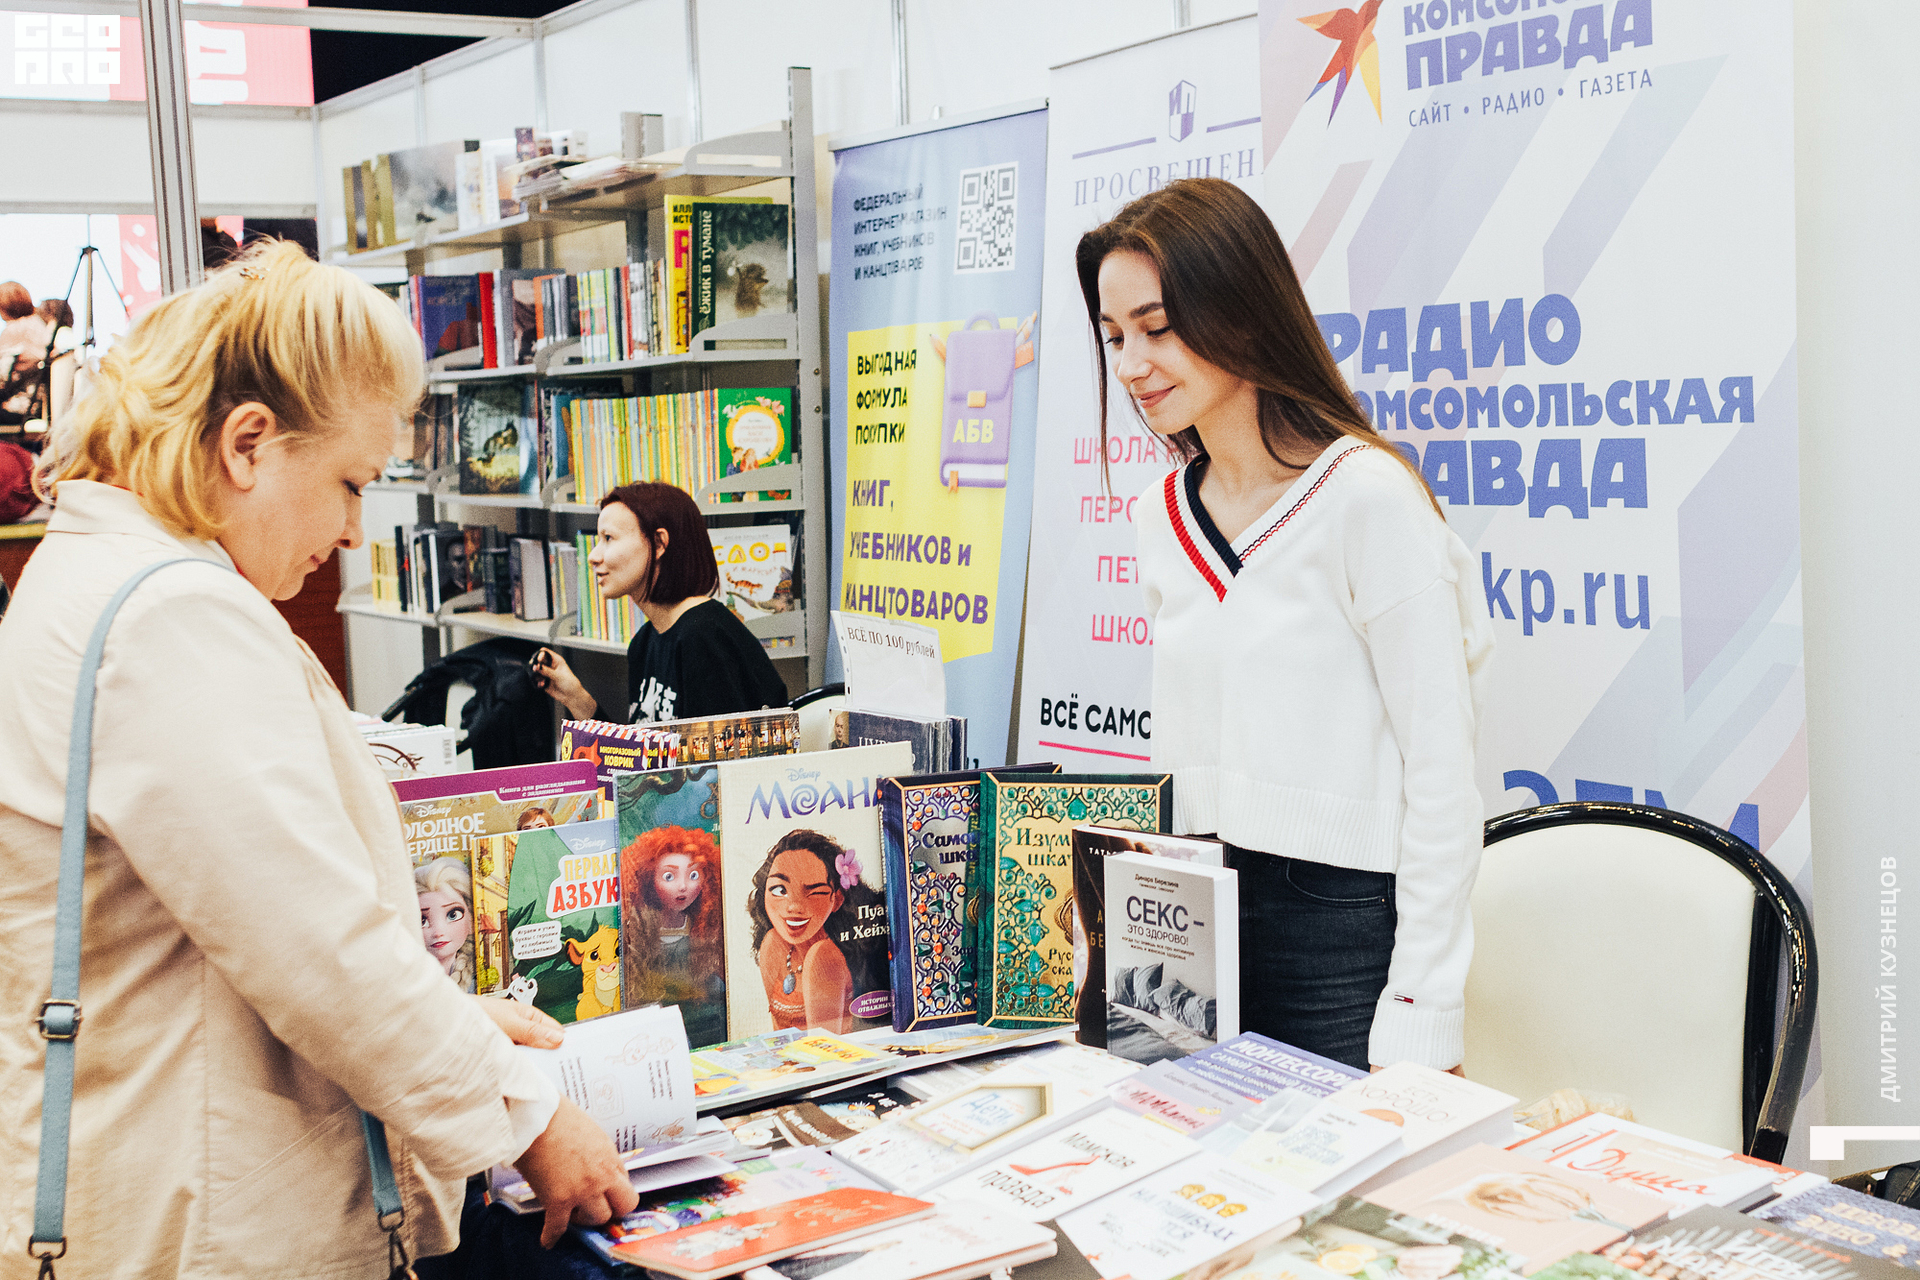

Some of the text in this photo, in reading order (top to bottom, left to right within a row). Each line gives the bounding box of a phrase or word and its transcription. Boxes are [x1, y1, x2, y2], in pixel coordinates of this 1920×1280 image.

[1405, 0, 1653, 90] ПРАВДА
[1408, 68, 1652, 127] САЙТ РАДИО ГАЗЕТА
[1074, 148, 1264, 206] ПРОСВЕЩЕН
[854, 266, 861, 280] И
[1315, 294, 1581, 382] РАДИО
[857, 349, 917, 376] ВЫГОДНАЯ
[856, 387, 908, 410] ФОРМУЛА
[1353, 376, 1755, 430] МСОМОЛЬСКАЯ
[855, 423, 905, 445] ПОКУПКИ
[953, 418, 994, 444] АБВ
[1392, 437, 1648, 519] АВДА
[852, 480, 893, 512] КНИГ,
[850, 532, 951, 566] УЧЕБНИКОВ
[845, 584, 989, 624] КАНЦТОВАРОВ
[1481, 552, 1650, 636] kp.ru
[847, 625, 935, 658] ВСЁ ПО 100 рублей
[1091, 614, 1154, 645] ШКО
[1040, 693, 1079, 730] ВСЁ
[604, 755, 635, 768] КОВРИК
[785, 768, 821, 782] Disney
[414, 804, 452, 818] Disney
[745, 776, 878, 824] МОАН
[403, 811, 487, 841] ОЛОДНОЕ
[407, 836, 461, 858] ЕРДЦЕ
[570, 837, 606, 851] Disney
[564, 853, 617, 882] ПЕРВАЯ
[1028, 854, 1072, 867] шка
[857, 904, 885, 920] Пуа
[1126, 895, 1189, 932] СЕКС
[840, 931, 849, 942] и
[1127, 924, 1189, 946] ЭТО ЗДОРОВО!
